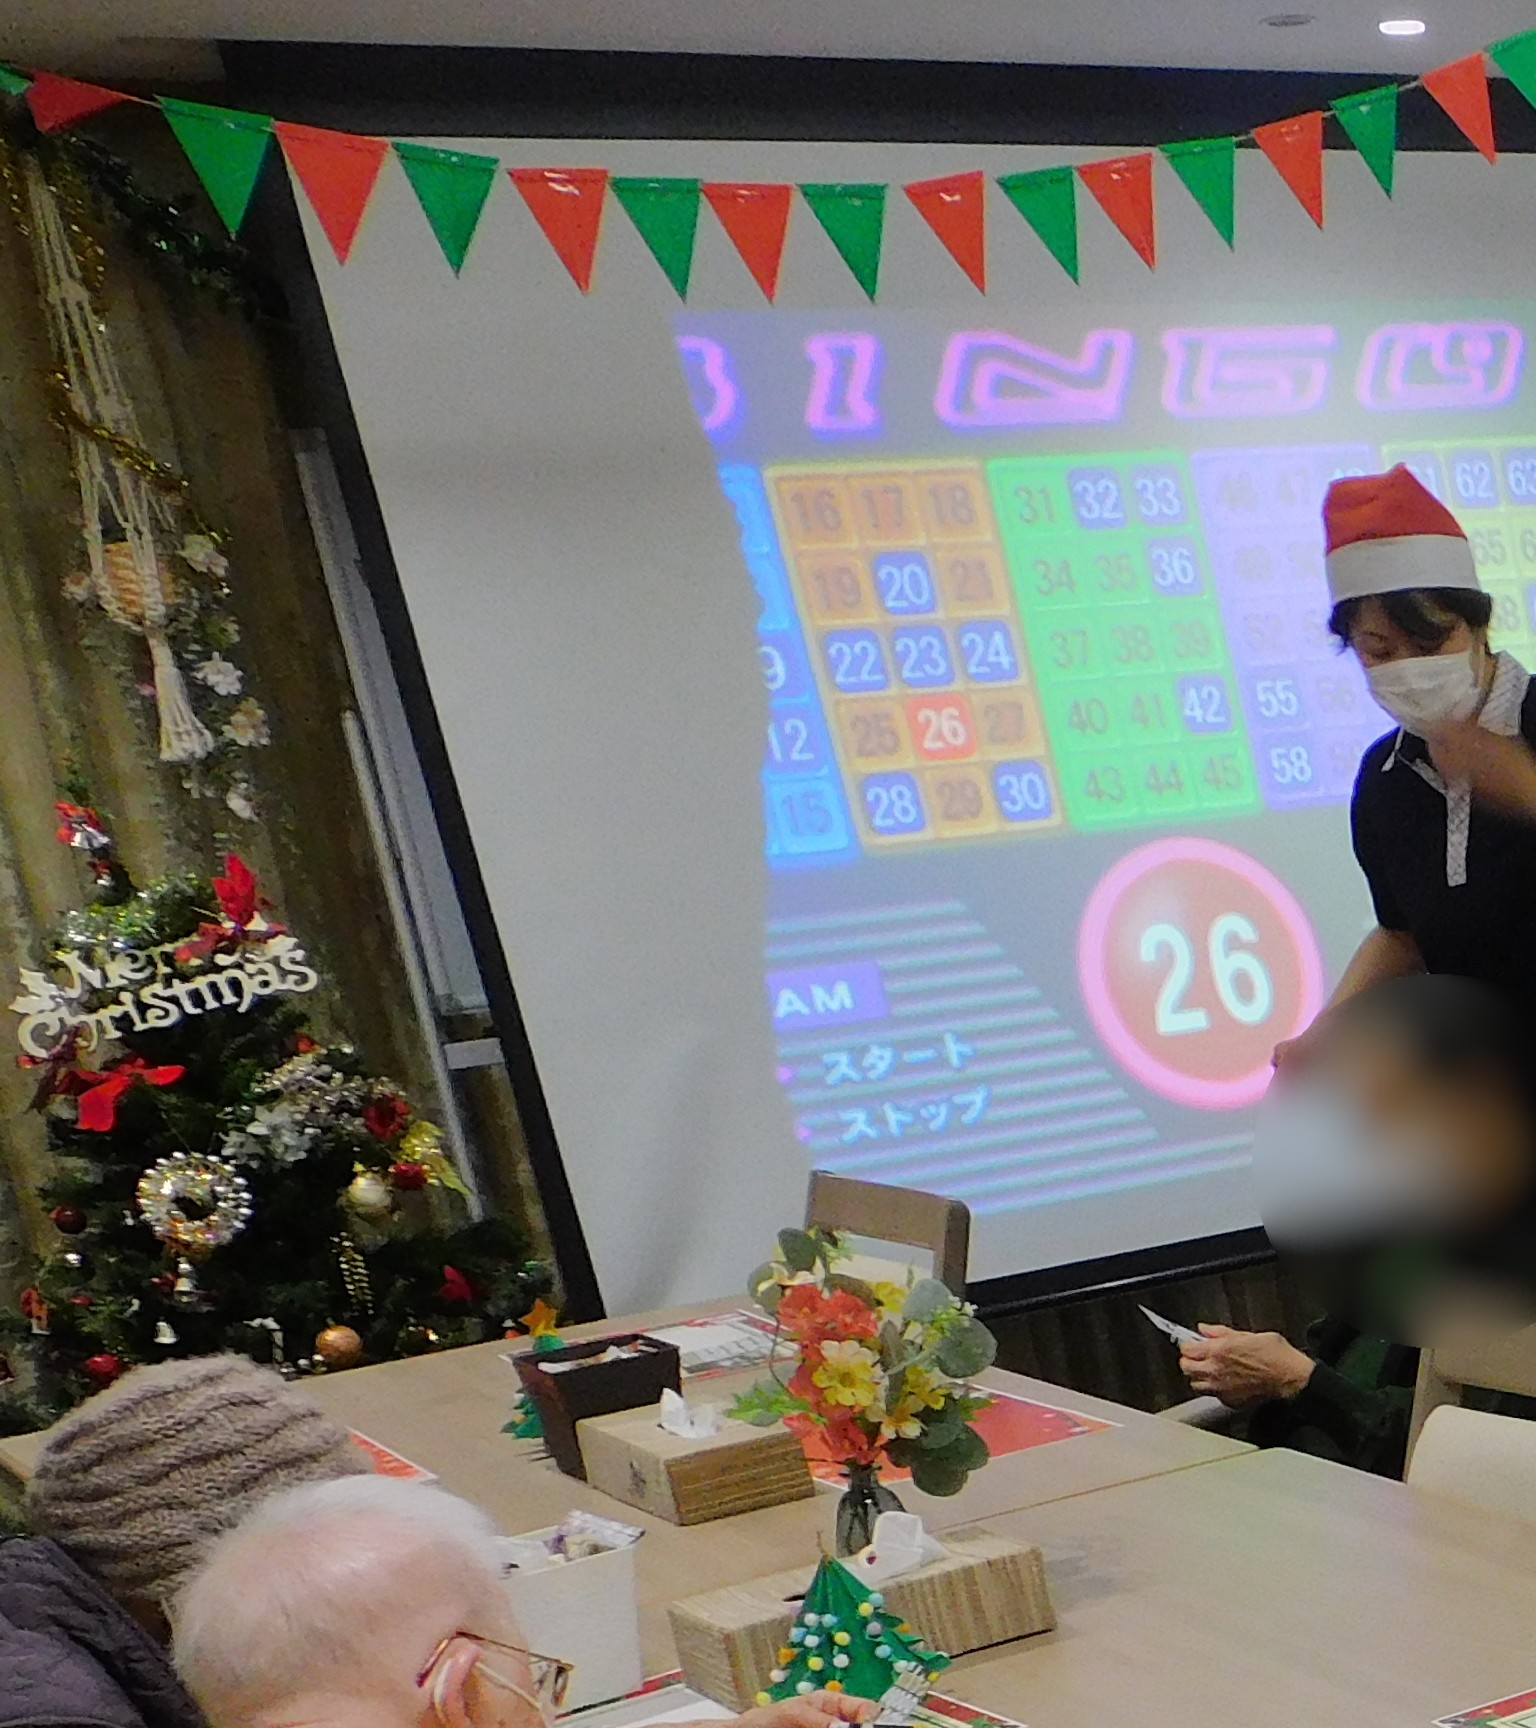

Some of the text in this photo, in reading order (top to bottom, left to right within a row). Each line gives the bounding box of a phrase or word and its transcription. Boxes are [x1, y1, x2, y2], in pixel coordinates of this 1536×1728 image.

[790, 486, 842, 532] 16
[860, 483, 904, 529] 17
[928, 483, 977, 526] 18
[1014, 484, 1056, 524] 31
[1073, 478, 1124, 520] 32
[1136, 477, 1181, 517] 33
[1455, 462, 1495, 499] 62
[812, 565, 862, 610] 19
[877, 562, 931, 608] 20
[1033, 558, 1077, 597] 34
[1151, 546, 1195, 587] 36
[828, 640, 886, 685] 22
[894, 634, 948, 679] 23
[960, 630, 1014, 674] 24
[1050, 628, 1088, 669] 37
[768, 717, 815, 763] 12
[916, 705, 968, 750] 26
[1068, 697, 1109, 735] 40
[1131, 692, 1166, 728] 41
[1183, 685, 1227, 724] 42
[1256, 677, 1299, 718] 55
[867, 784, 918, 828] 28
[999, 772, 1047, 813] 30
[1084, 766, 1125, 805] 43
[1146, 759, 1185, 796] 44
[1270, 746, 1313, 785] 58
[1139, 912, 1274, 1036] 26
[821, 1031, 977, 1086] スタート
[838, 1082, 990, 1144] ストップ
